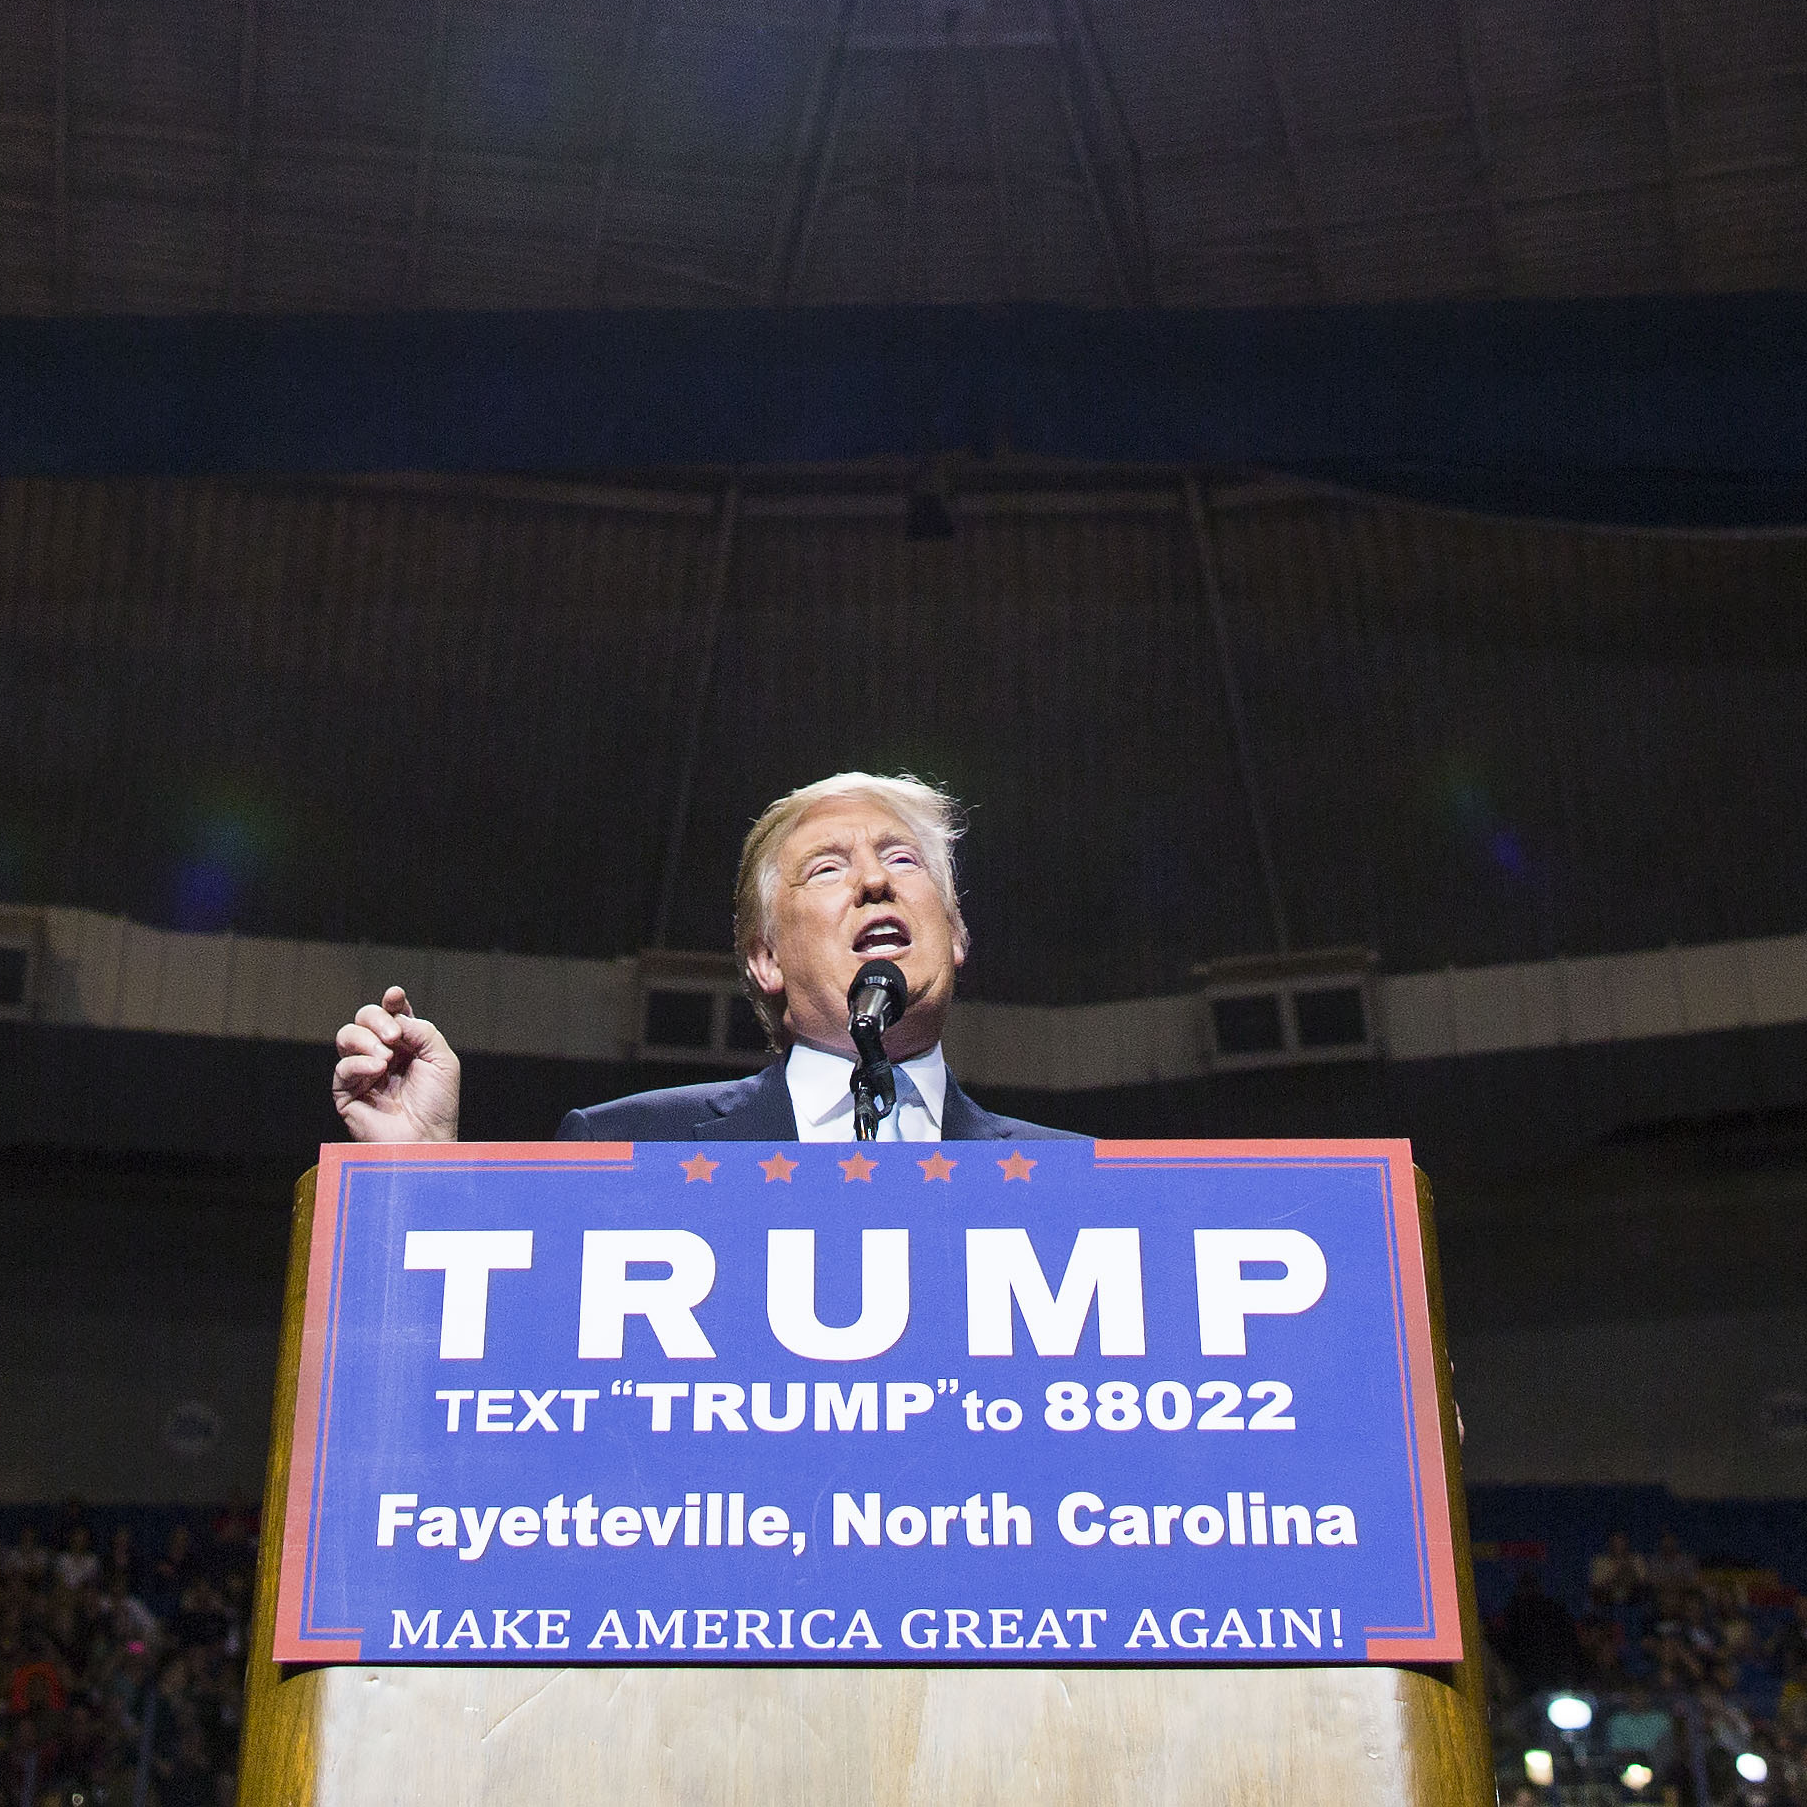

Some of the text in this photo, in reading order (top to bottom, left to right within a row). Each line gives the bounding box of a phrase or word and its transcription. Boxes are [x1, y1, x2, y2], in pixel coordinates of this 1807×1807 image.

[403, 1227, 1328, 1361] TRUMP
[435, 1389, 600, 1433] TEXT
[961, 1389, 1024, 1433] to
[1043, 1380, 1297, 1432] 88022
[376, 1491, 1358, 1560] Fayetteville, North Carolina
[388, 1608, 1344, 1650] MAKE AMERICA GREAT AGAIN!
